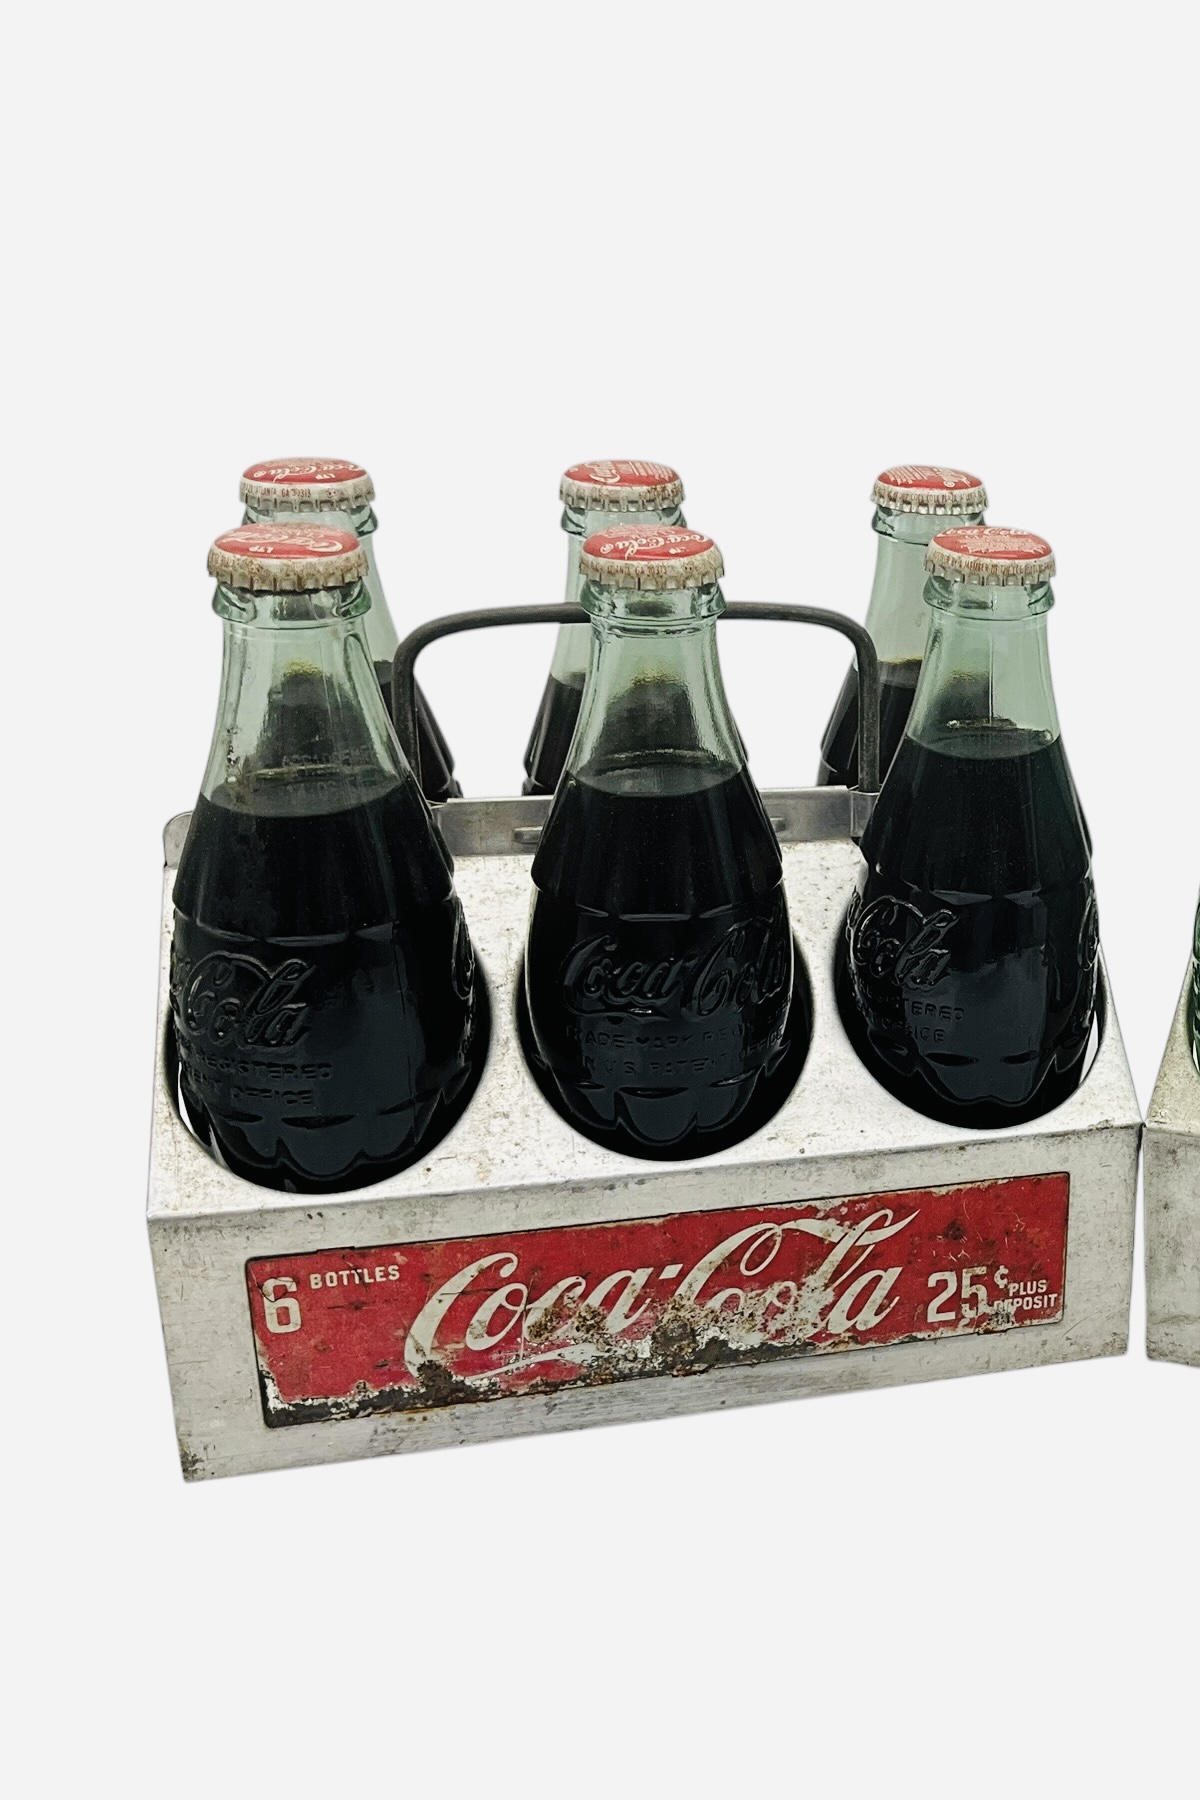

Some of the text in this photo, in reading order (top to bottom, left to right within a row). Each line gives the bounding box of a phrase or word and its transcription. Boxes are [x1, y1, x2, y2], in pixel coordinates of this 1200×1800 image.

[262, 1264, 401, 1334] 6 BOTTLES
[404, 1208, 920, 1381] Coca-Cola
[1008, 1279, 1047, 1297] PLUS
